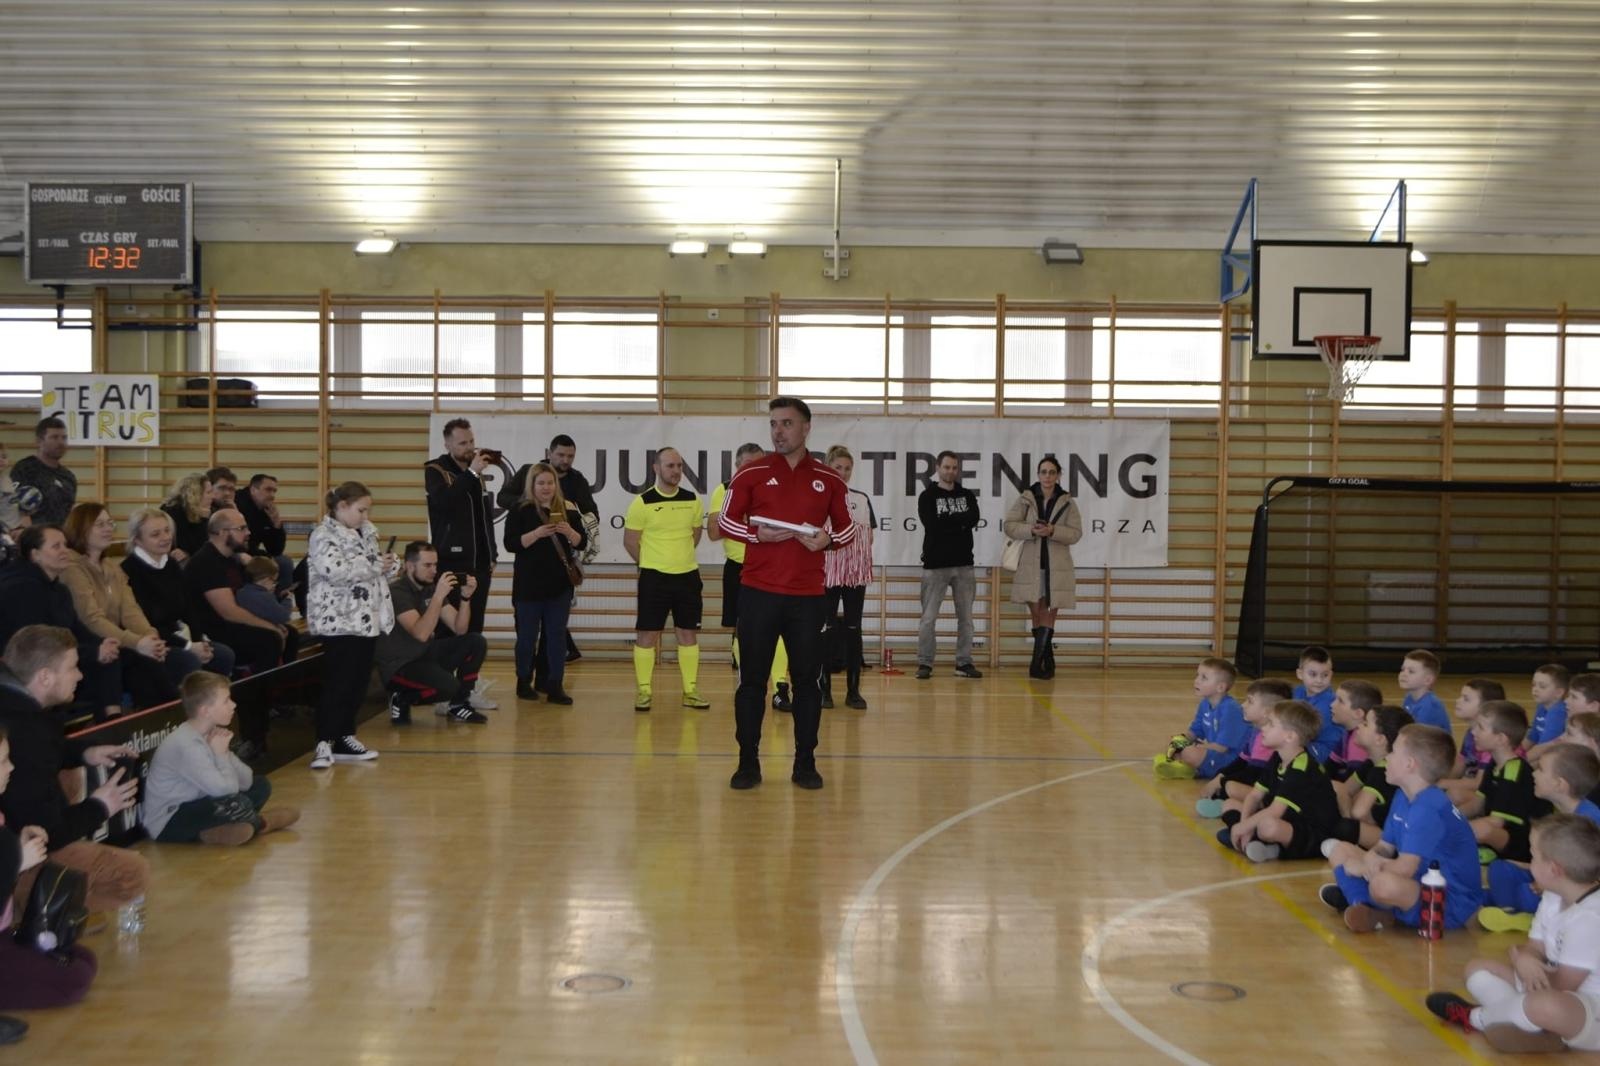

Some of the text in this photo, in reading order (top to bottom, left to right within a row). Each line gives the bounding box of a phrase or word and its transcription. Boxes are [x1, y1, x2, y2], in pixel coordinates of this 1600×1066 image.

[31, 188, 89, 203] GOSPODARZE
[113, 195, 127, 204] GRY
[141, 185, 181, 203] GOŚCIE
[79, 232, 138, 244] CZAS GRY
[87, 247, 141, 269] 12:32
[54, 383, 152, 410] TEAM
[860, 451, 1158, 499] TRENNG
